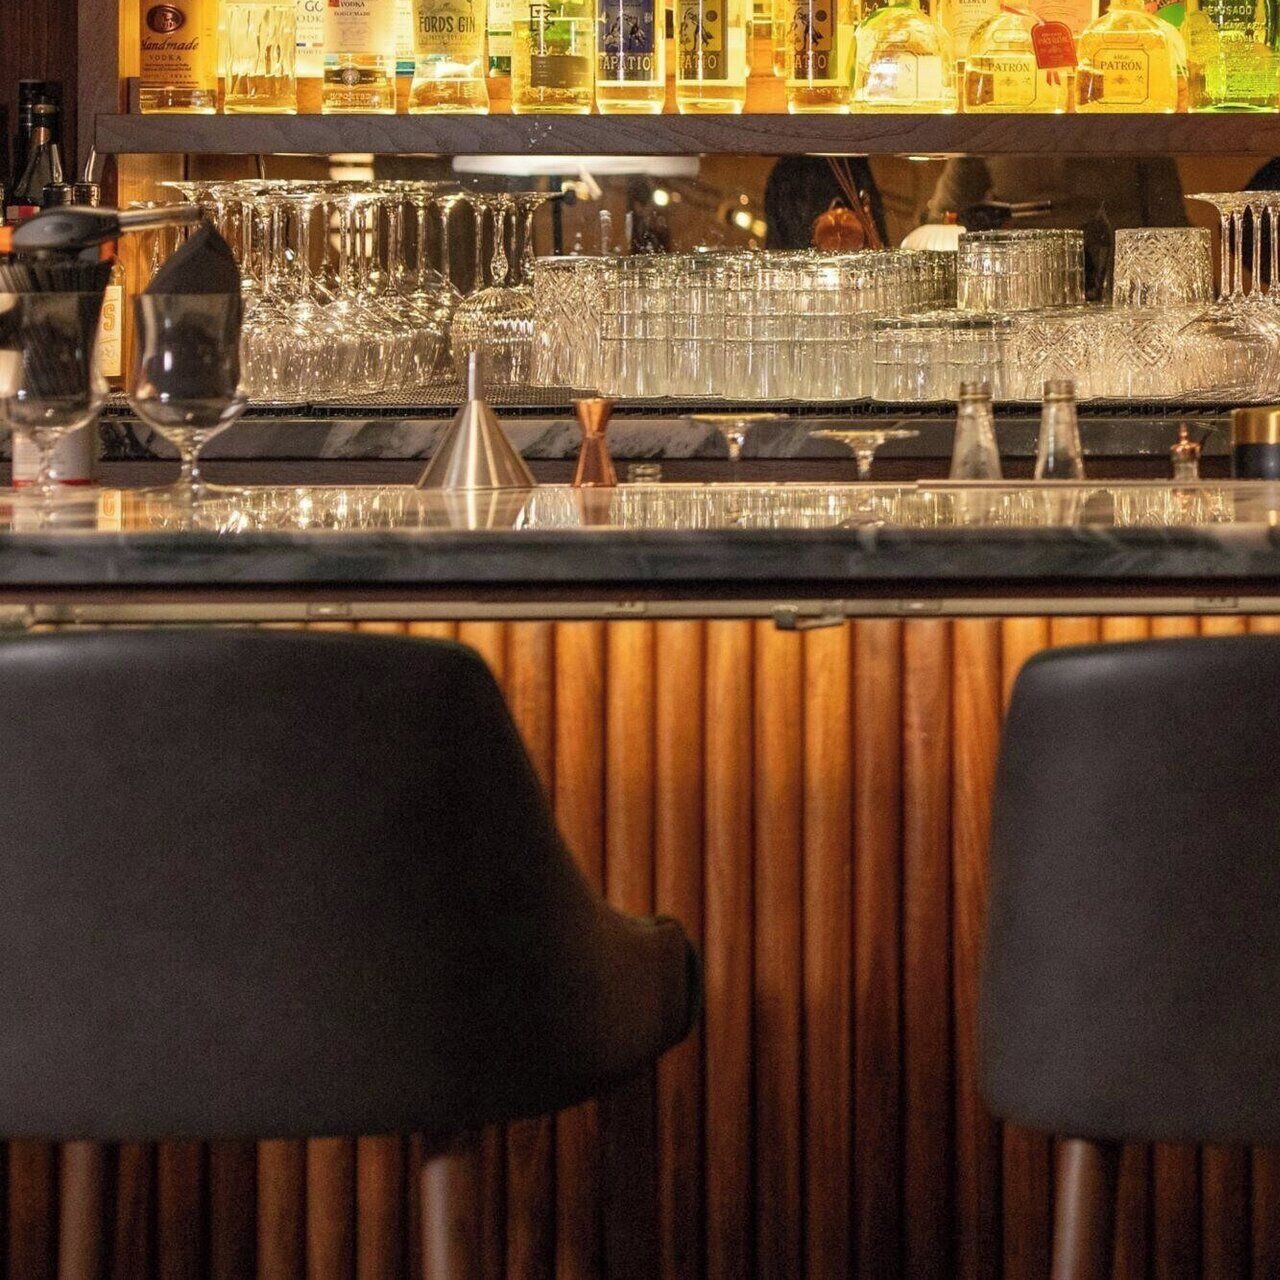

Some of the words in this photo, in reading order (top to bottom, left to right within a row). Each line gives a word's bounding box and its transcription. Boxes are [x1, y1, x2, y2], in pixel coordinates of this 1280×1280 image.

[419, 16, 453, 32] FORDS
[458, 16, 475, 32] GIN
[141, 37, 199, 51] Handmade
[988, 61, 1030, 72] PATRÓN
[1100, 59, 1143, 70] PATRÓN
